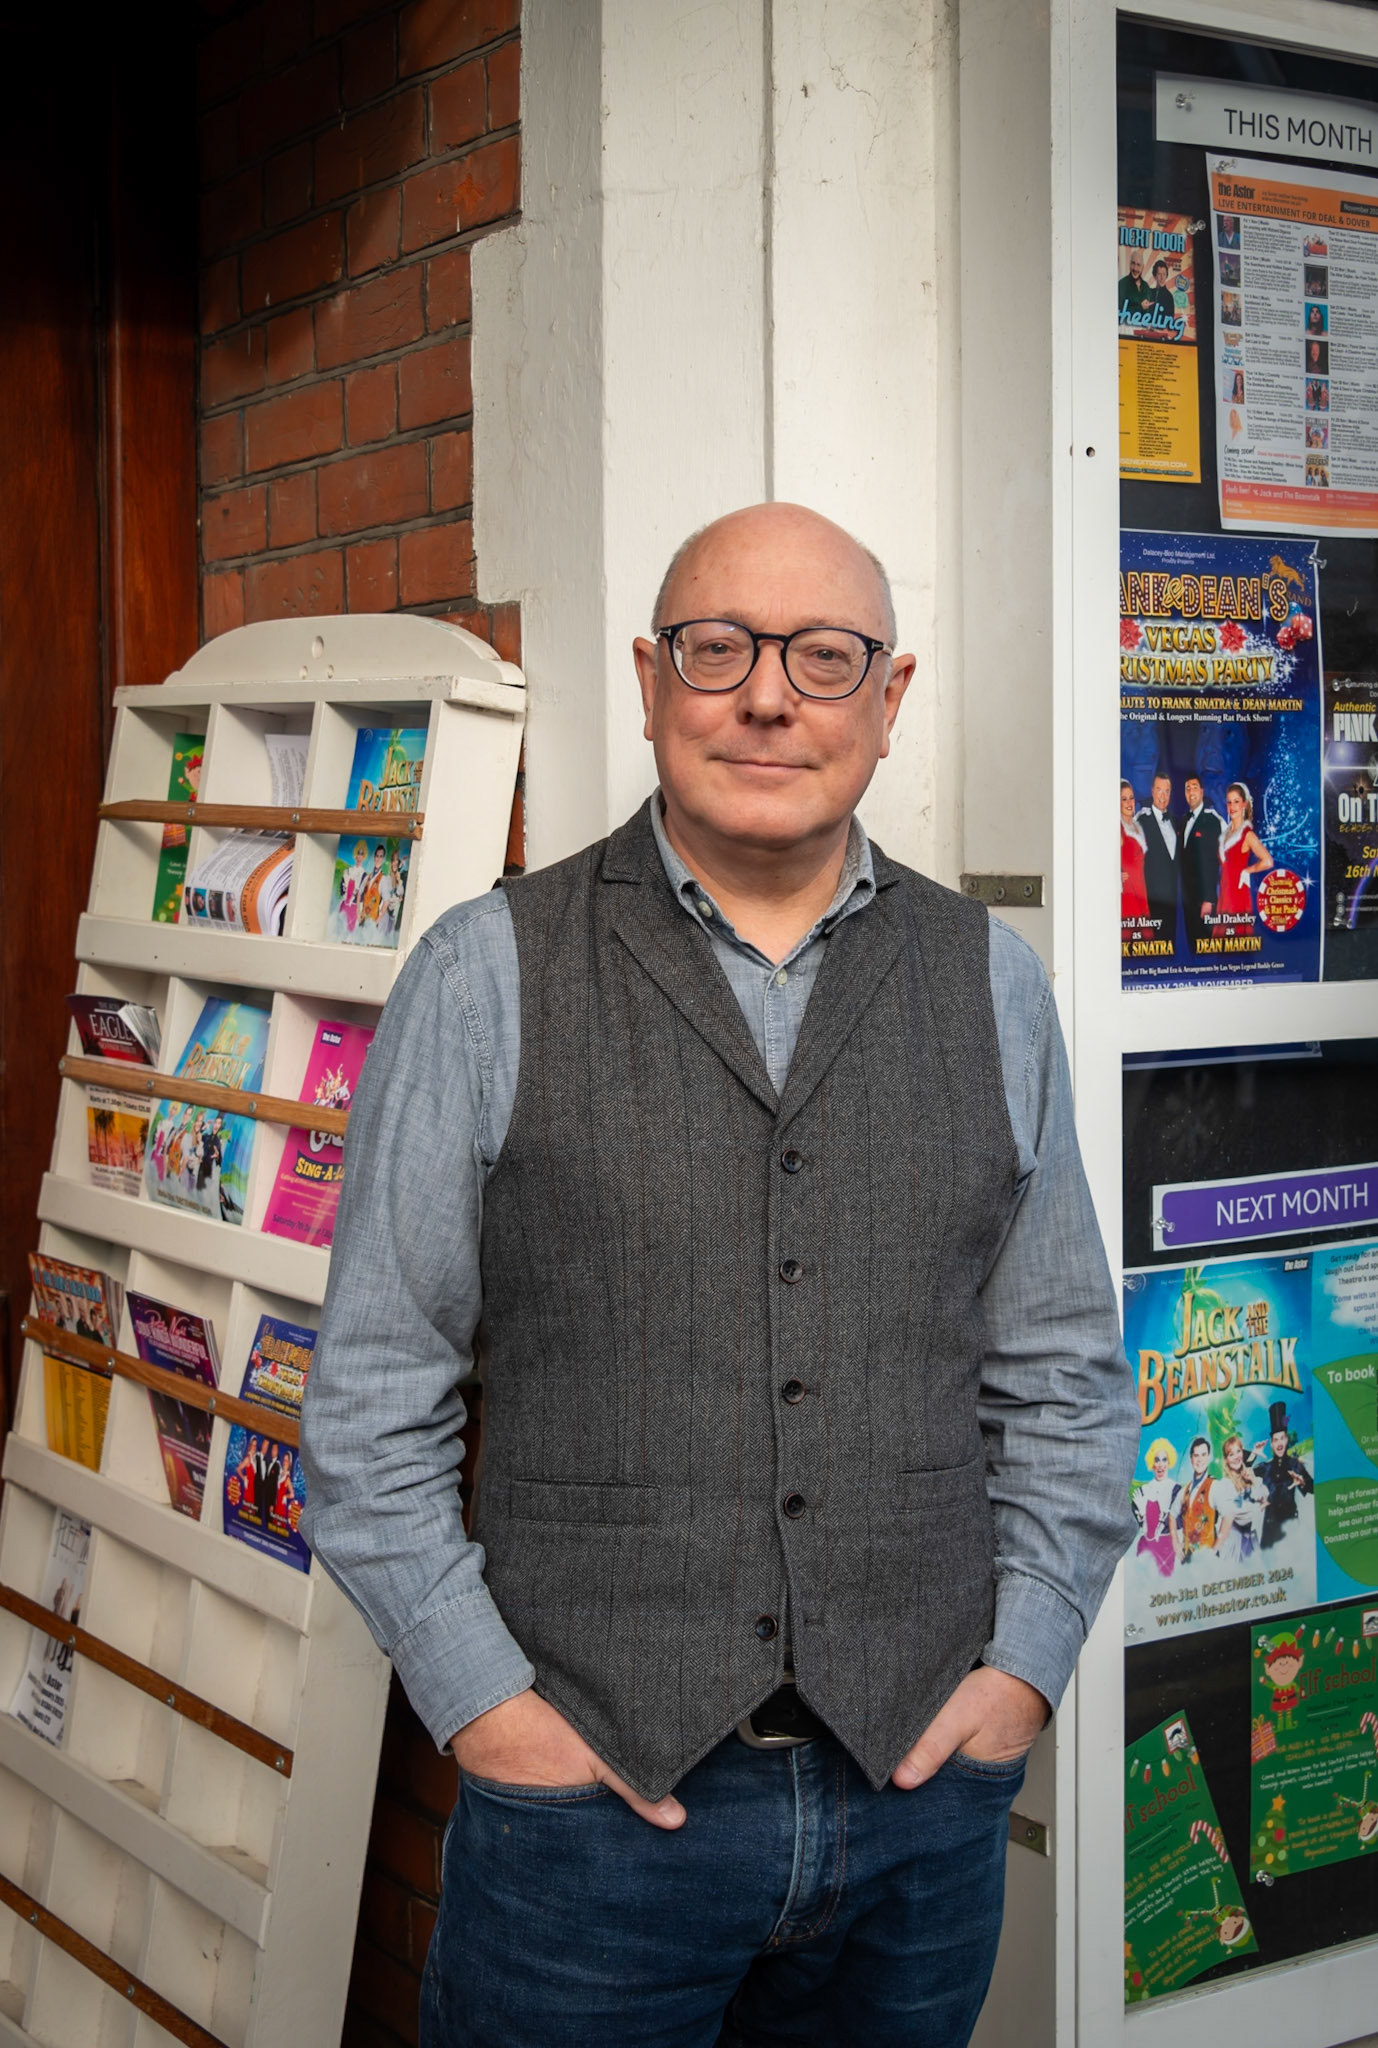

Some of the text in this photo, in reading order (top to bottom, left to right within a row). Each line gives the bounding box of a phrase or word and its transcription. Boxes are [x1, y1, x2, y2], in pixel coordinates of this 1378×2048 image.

[1224, 108, 1372, 155] THIS MONTH
[1218, 182, 1255, 200] the Astor
[1218, 199, 1371, 228] LIVE ENTERTAINMENT FOR DEAL & DOVER
[1120, 226, 1186, 253] NEXT DOOR
[1145, 626, 1217, 652] VEGAS
[1212, 655, 1274, 685] PARTY
[1147, 696, 1161, 709] TO
[1161, 696, 1193, 710] FRANK
[1193, 697, 1233, 711] SINATRA
[1233, 698, 1240, 711] &
[1242, 698, 1267, 711] DEAN
[1268, 698, 1303, 712] MARTIN
[1334, 701, 1377, 713] Authentic
[1129, 712, 1158, 723] Original
[1158, 712, 1165, 721] &
[1166, 712, 1192, 724] Longest
[1193, 713, 1222, 723] Running
[1222, 713, 1235, 722] Rat
[1236, 713, 1251, 722] Pack
[1252, 713, 1273, 723] Show!
[1333, 713, 1378, 743] PINK
[378, 746, 414, 791] JACK
[1338, 792, 1362, 823] On
[1345, 865, 1371, 879] 16th
[1266, 888, 1296, 896] Christmas
[1270, 896, 1293, 905] Classics
[1264, 906, 1299, 915] & Rat Pack
[1136, 917, 1163, 930] Alacey
[1204, 913, 1257, 927] Paul Drakeley
[1132, 932, 1142, 940] as
[1226, 927, 1236, 936] as
[1132, 940, 1174, 957] SINATRA
[1196, 936, 1262, 955] DEAN MARTIN
[1149, 967, 1157, 977] Big
[1158, 967, 1169, 975] Band
[1170, 966, 1178, 974] Era
[1183, 965, 1214, 974] Arrangements
[1214, 964, 1219, 973] by
[1220, 964, 1228, 972] Las
[1228, 963, 1241, 972] Vegas
[1241, 962, 1257, 971] Legend
[1217, 1182, 1369, 1227] NEXT MONTH
[1295, 1260, 1309, 1270] Astor
[1343, 1265, 1354, 1273] out
[1355, 1262, 1369, 1271] loud
[1353, 1292, 1368, 1300] with
[1354, 1303, 1375, 1313] sprout
[1175, 1292, 1244, 1360] JACK
[1364, 1314, 1376, 1322] and
[1138, 1337, 1304, 1427] BEANSTALK
[1327, 1364, 1375, 1385] To book
[1336, 1491, 1354, 1504] Pay it
[1328, 1500, 1371, 1519] help another
[1338, 1517, 1363, 1529] see our
[1324, 1528, 1371, 1545] Donate on our
[1149, 1567, 1294, 1609] 20th-31st DECEMBER 2024
[1156, 1587, 1287, 1628] www.theastor.co.uk
[1299, 1656, 1377, 1700] Elf school
[1124, 1803, 1136, 1835] lf
[1139, 1766, 1197, 1824] school
